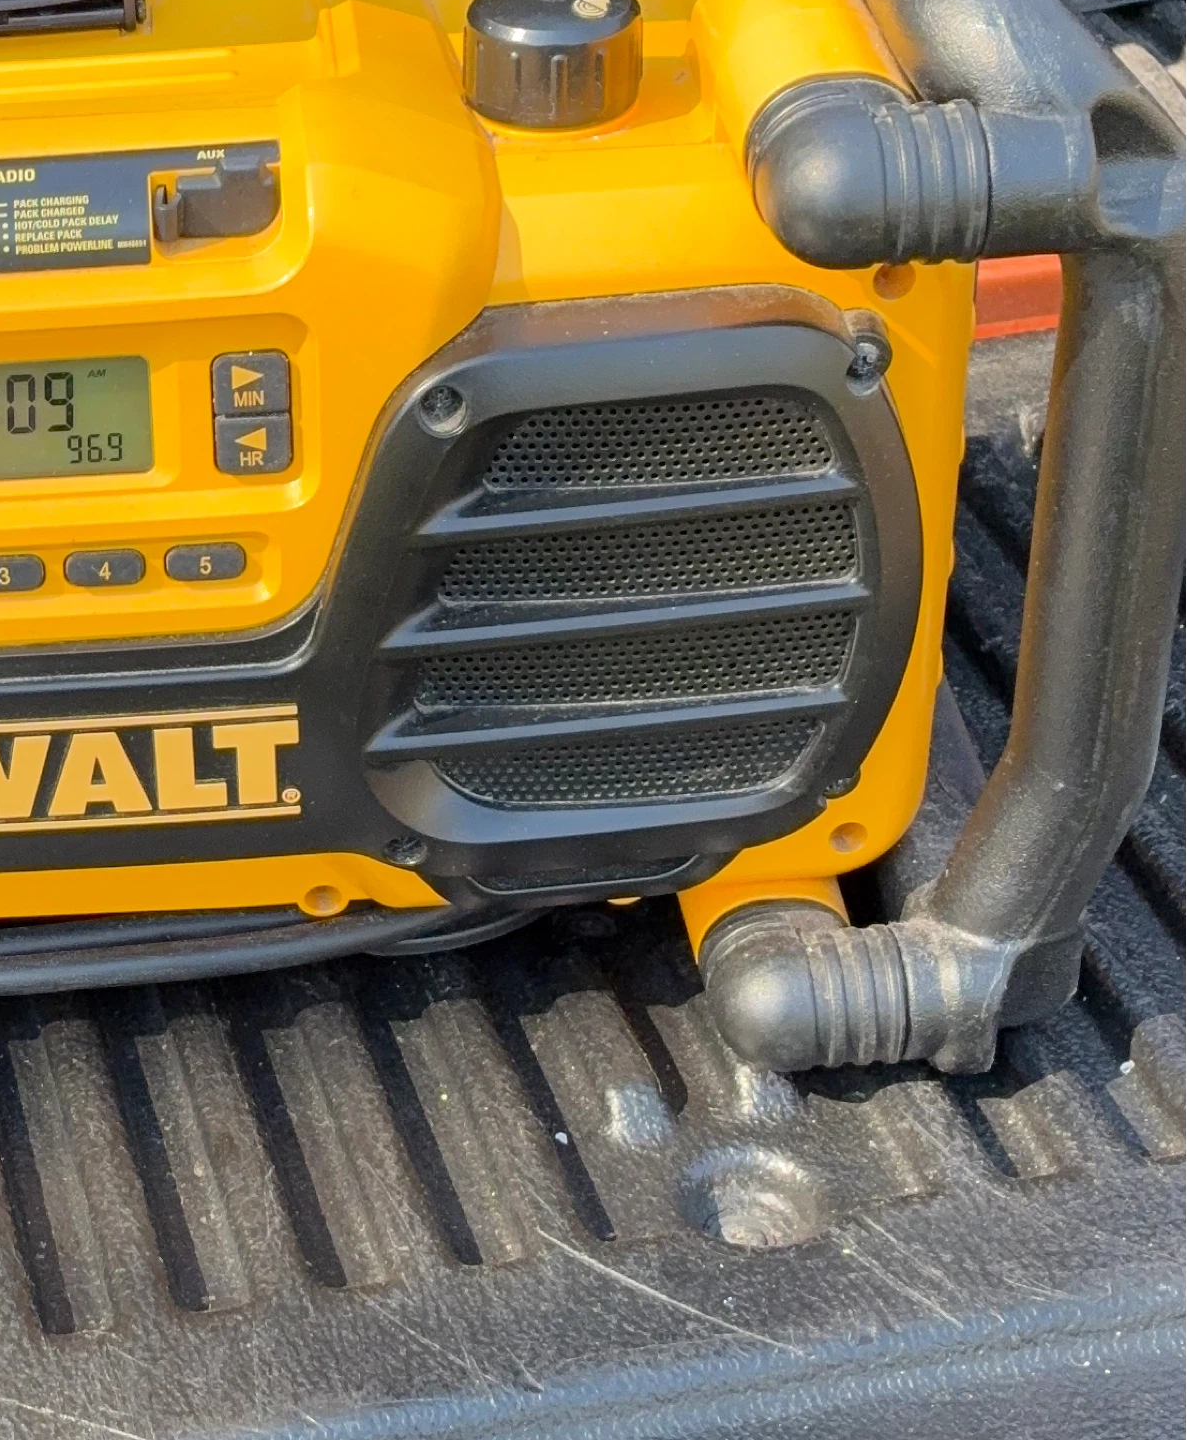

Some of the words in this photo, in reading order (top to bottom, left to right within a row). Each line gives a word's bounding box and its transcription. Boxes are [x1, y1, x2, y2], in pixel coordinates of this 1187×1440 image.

[196, 149, 225, 161] AUX
[13, 198, 39, 209] PACK
[40, 195, 90, 207] CHARGING
[14, 208, 40, 220] PACK
[41, 206, 86, 218] CHARGED
[14, 218, 60, 231] HOT/COLD
[62, 216, 88, 227] PACK
[89, 214, 119, 226] DELAY
[15, 231, 56, 243] REPLACE
[57, 228, 83, 240] PACK
[15, 242, 60, 256] PROBLEM
[61, 238, 115, 253] POWERLINE
[87, 368, 107, 378] AM
[233, 390, 265, 407] MIN
[67, 432, 123, 464] 96.9
[239, 450, 265, 467] HR
[98, 562, 111, 581] 4
[199, 556, 212, 575] 5
